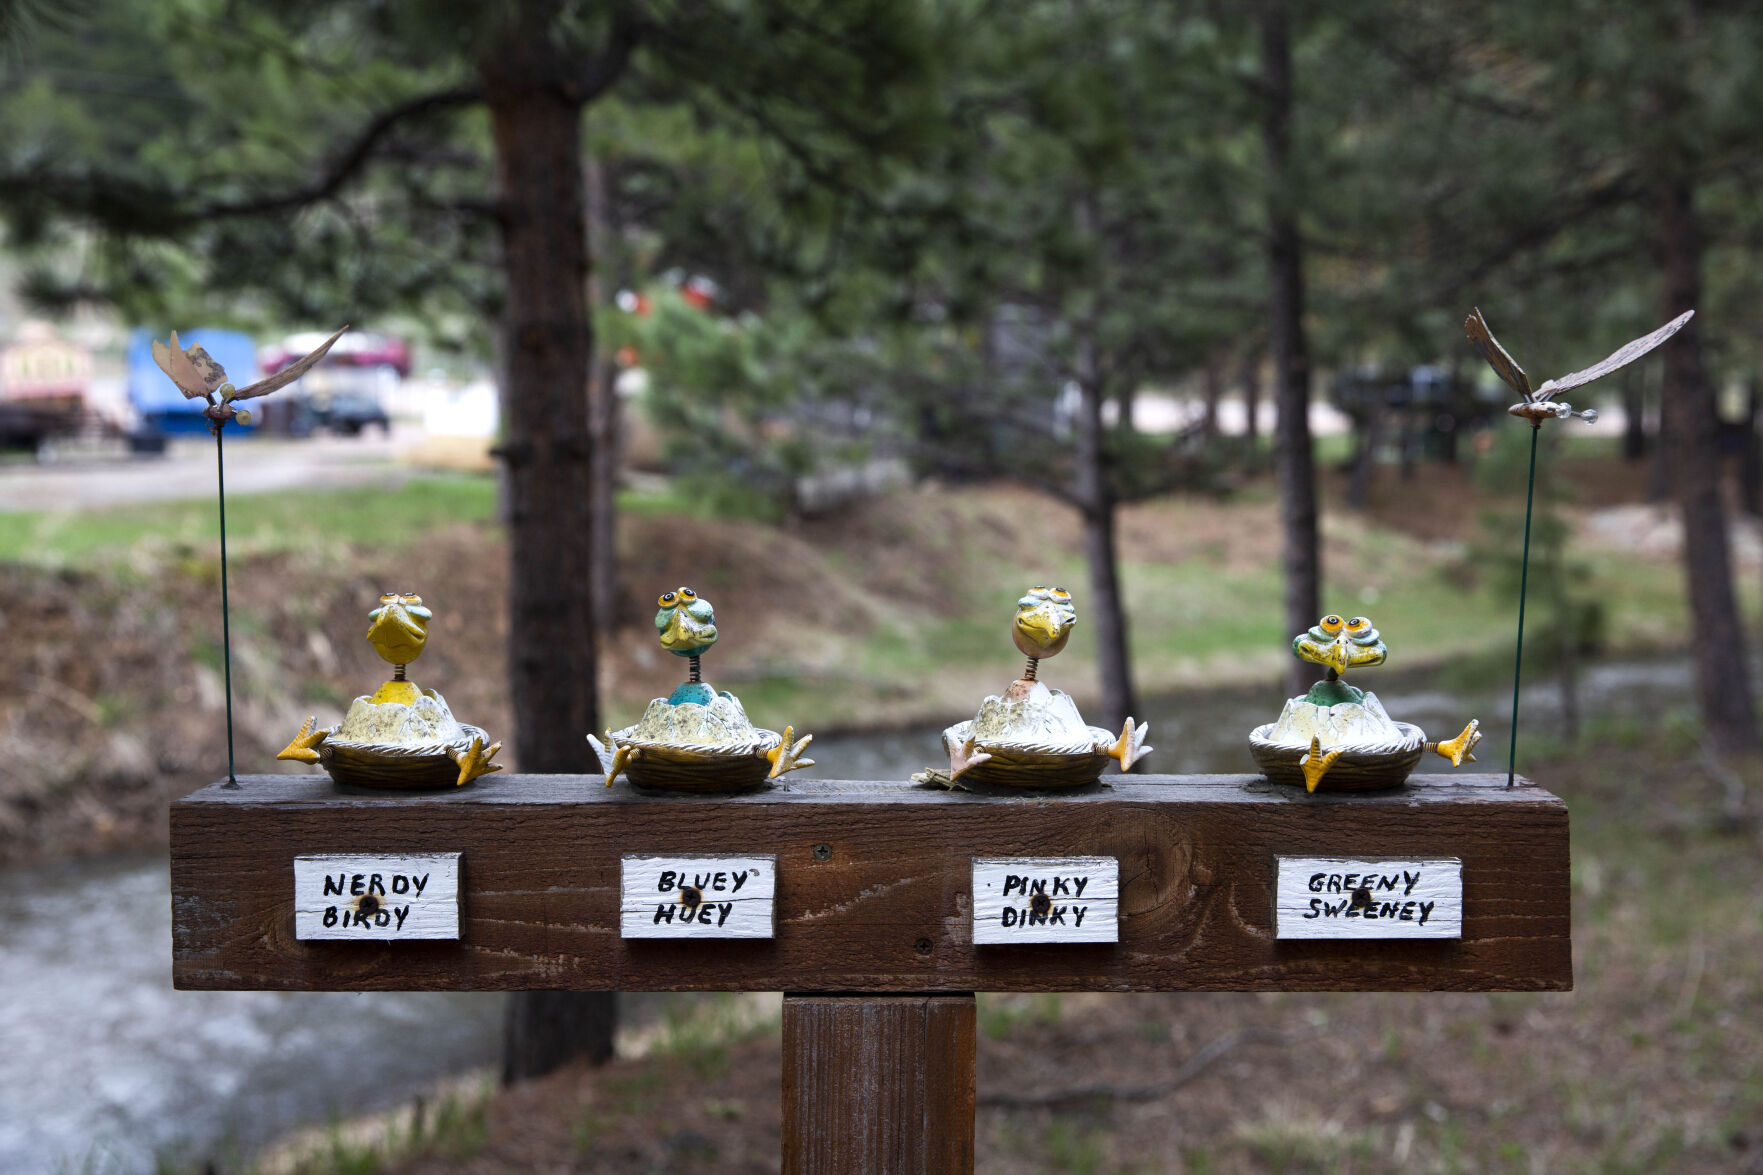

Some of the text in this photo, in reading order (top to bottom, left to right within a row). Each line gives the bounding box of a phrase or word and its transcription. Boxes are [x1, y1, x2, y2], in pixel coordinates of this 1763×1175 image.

[323, 873, 430, 898] NERDY
[657, 871, 748, 893] BLUEY
[1002, 875, 1088, 898] PINKY
[1308, 870, 1421, 896] GREENY
[322, 905, 410, 931] BIRDY
[653, 902, 733, 927] HUEY
[1001, 906, 1088, 928] DINKY
[1302, 898, 1435, 926] SWEENEY
